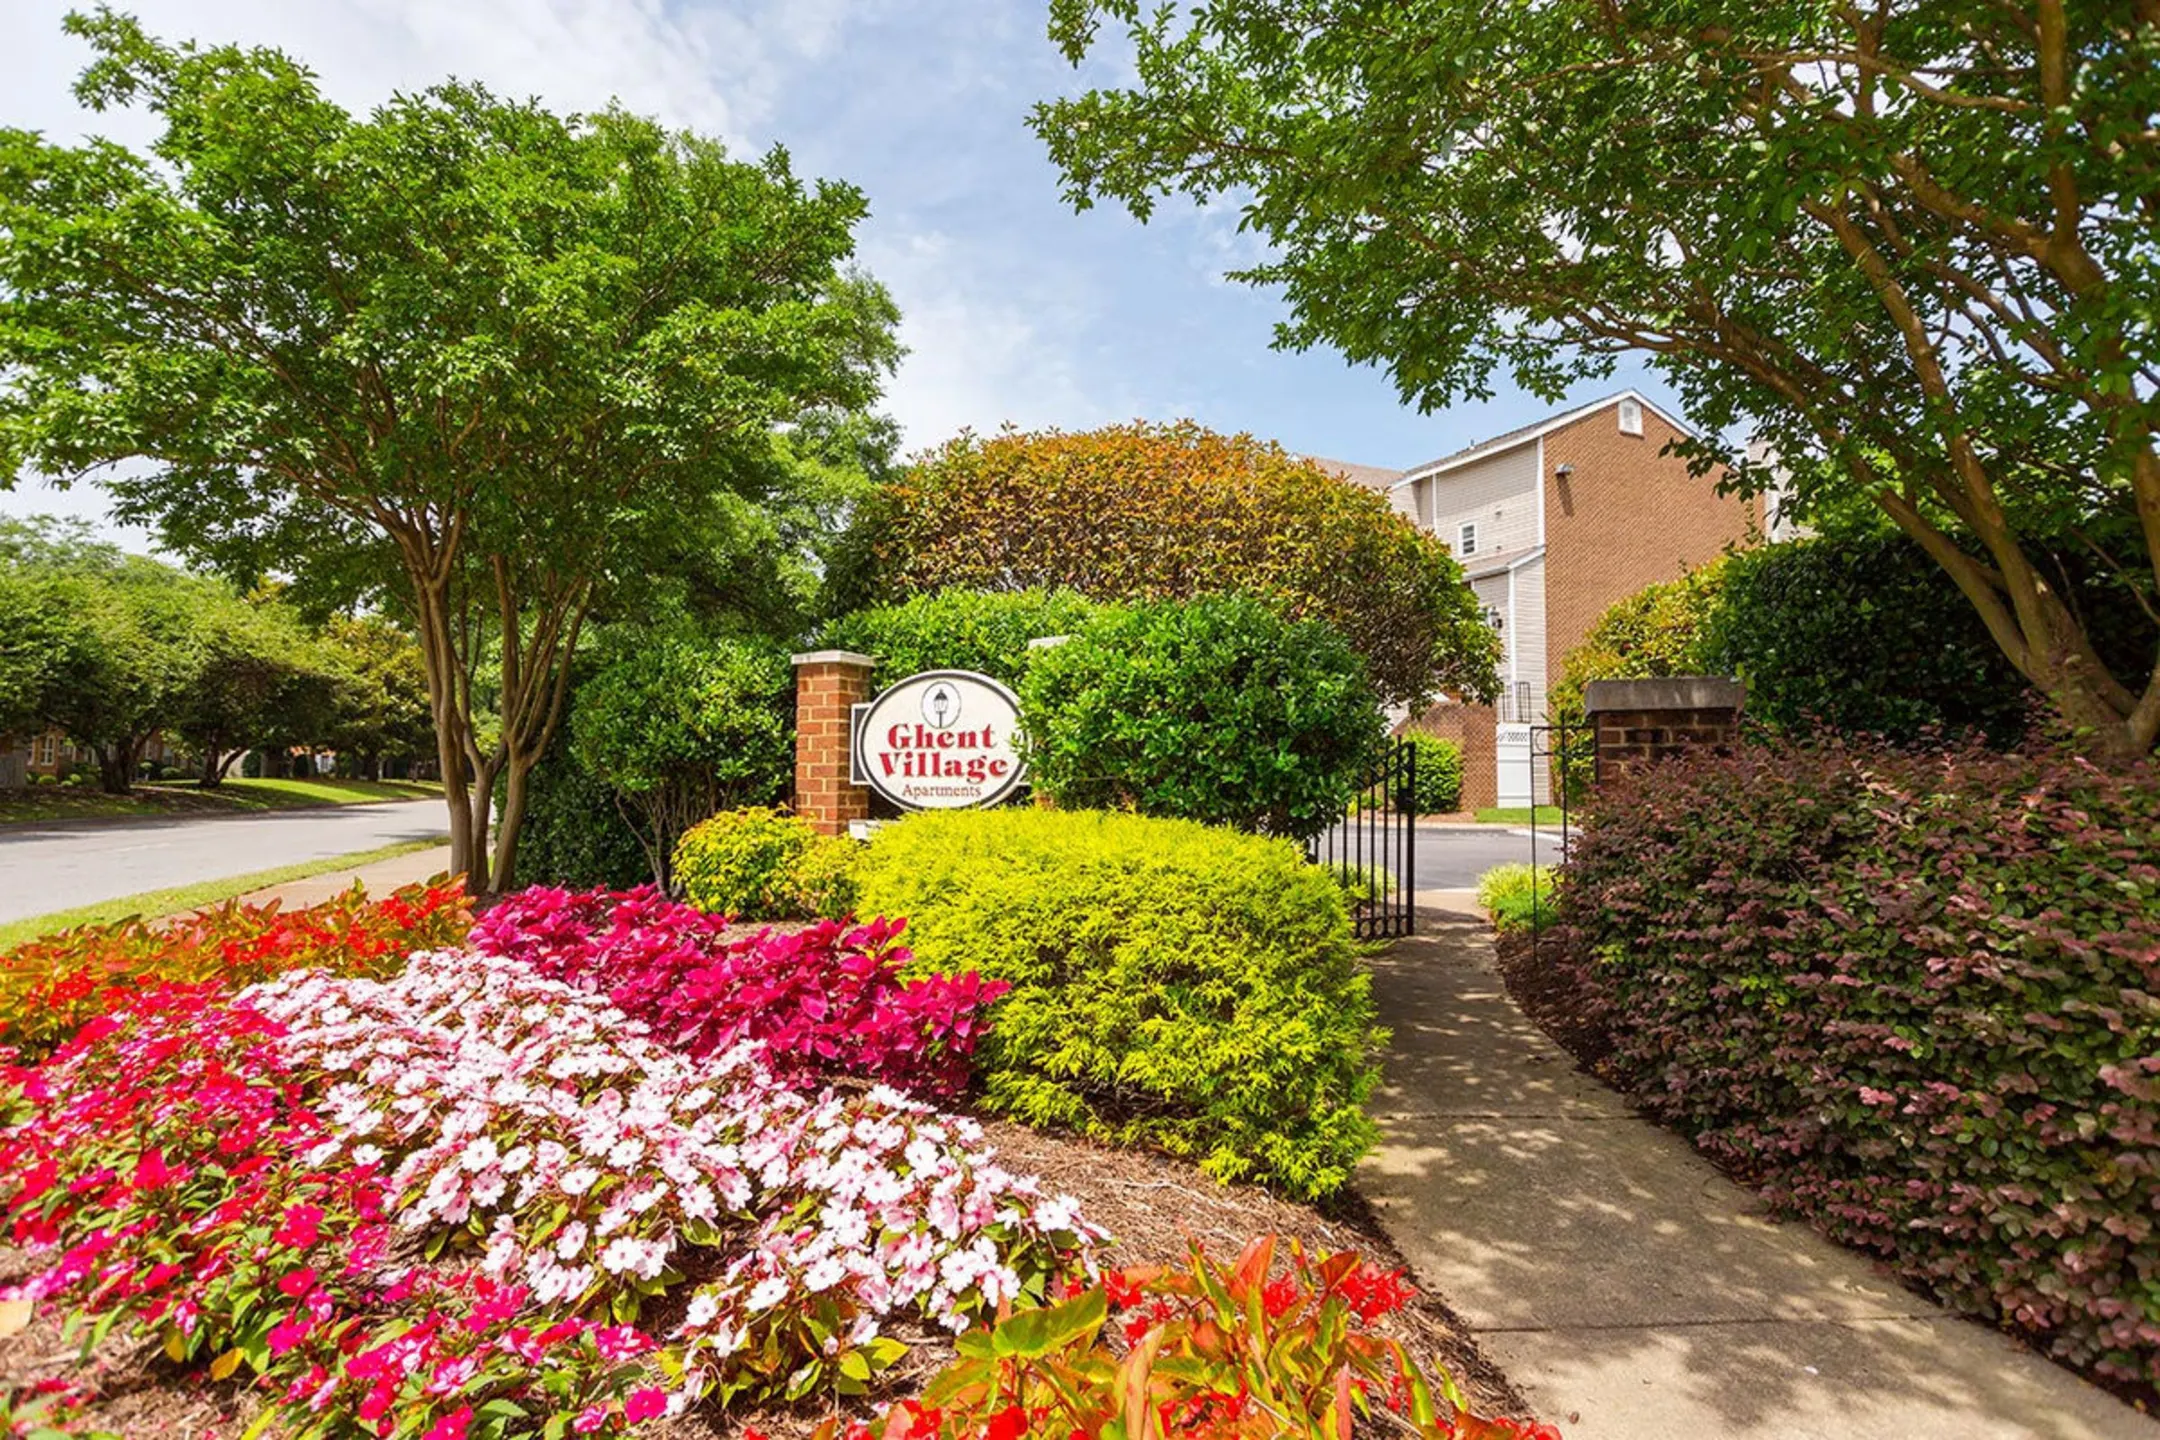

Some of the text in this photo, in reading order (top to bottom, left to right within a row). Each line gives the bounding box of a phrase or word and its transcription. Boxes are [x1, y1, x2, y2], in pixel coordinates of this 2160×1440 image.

[887, 723, 996, 749] Ghent
[879, 752, 1008, 784] Village
[902, 785, 982, 799] Apartments
